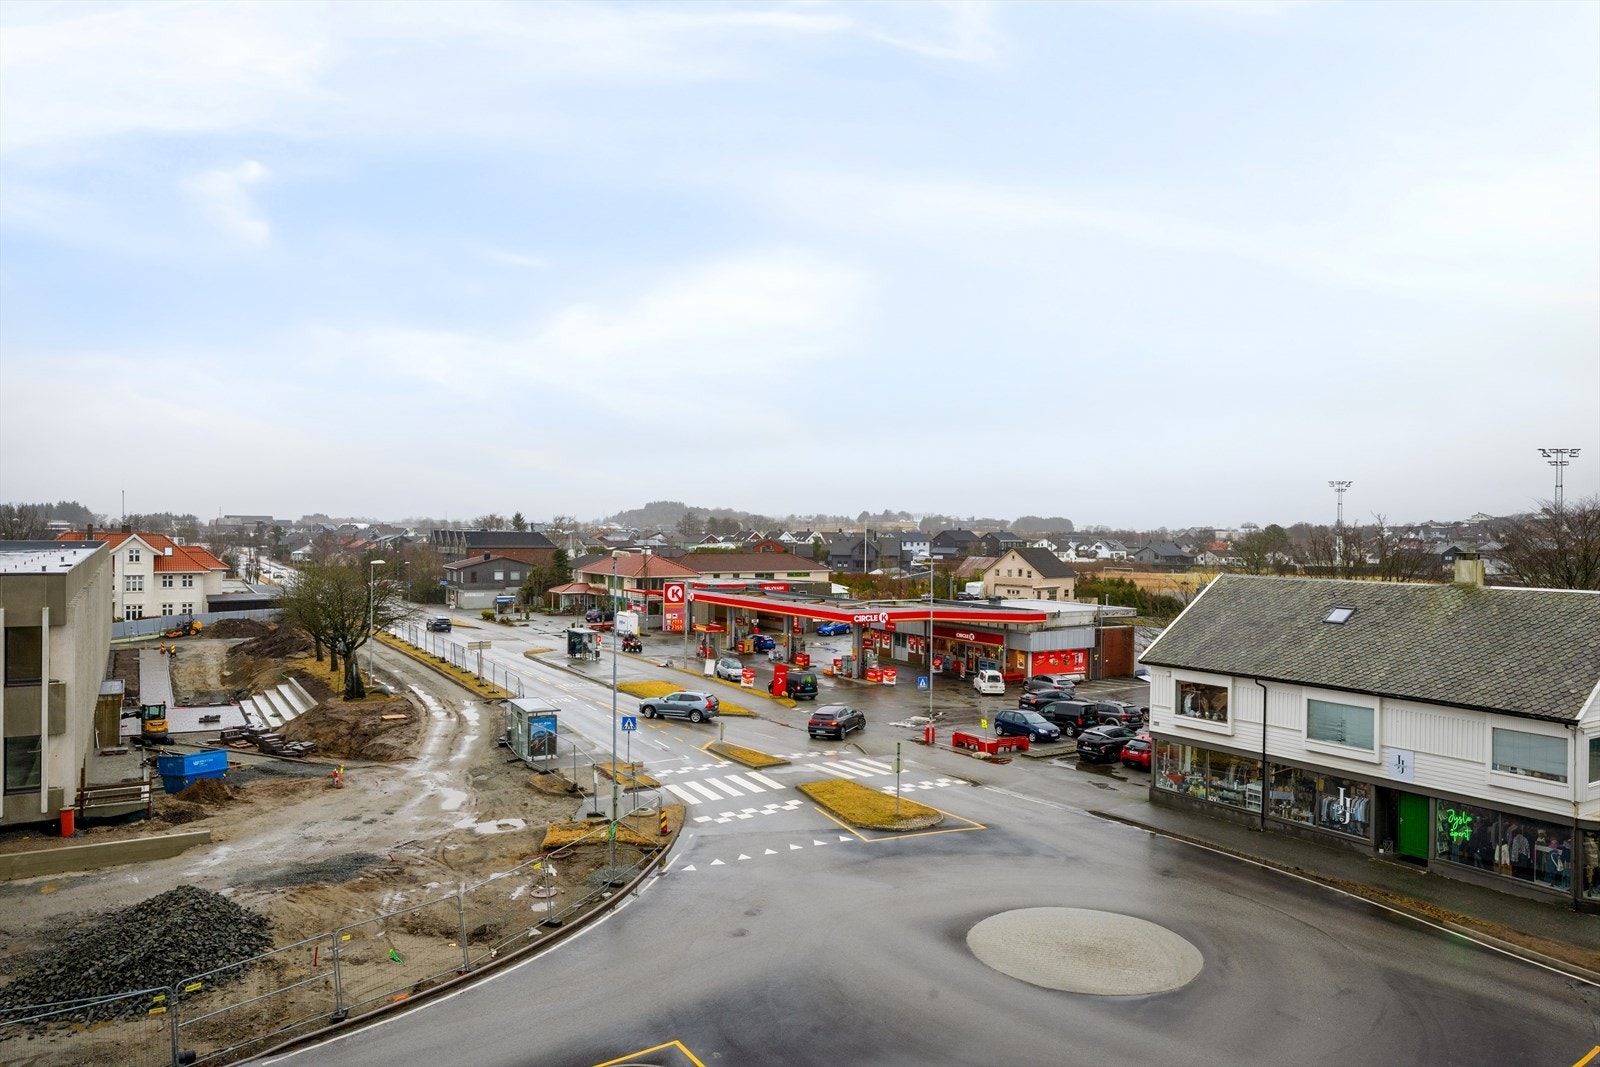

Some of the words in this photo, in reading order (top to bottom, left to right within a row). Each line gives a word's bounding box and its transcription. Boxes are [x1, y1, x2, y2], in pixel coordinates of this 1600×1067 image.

[669, 587, 683, 601] K
[854, 615, 879, 623] CIRCLE
[879, 613, 888, 624] K
